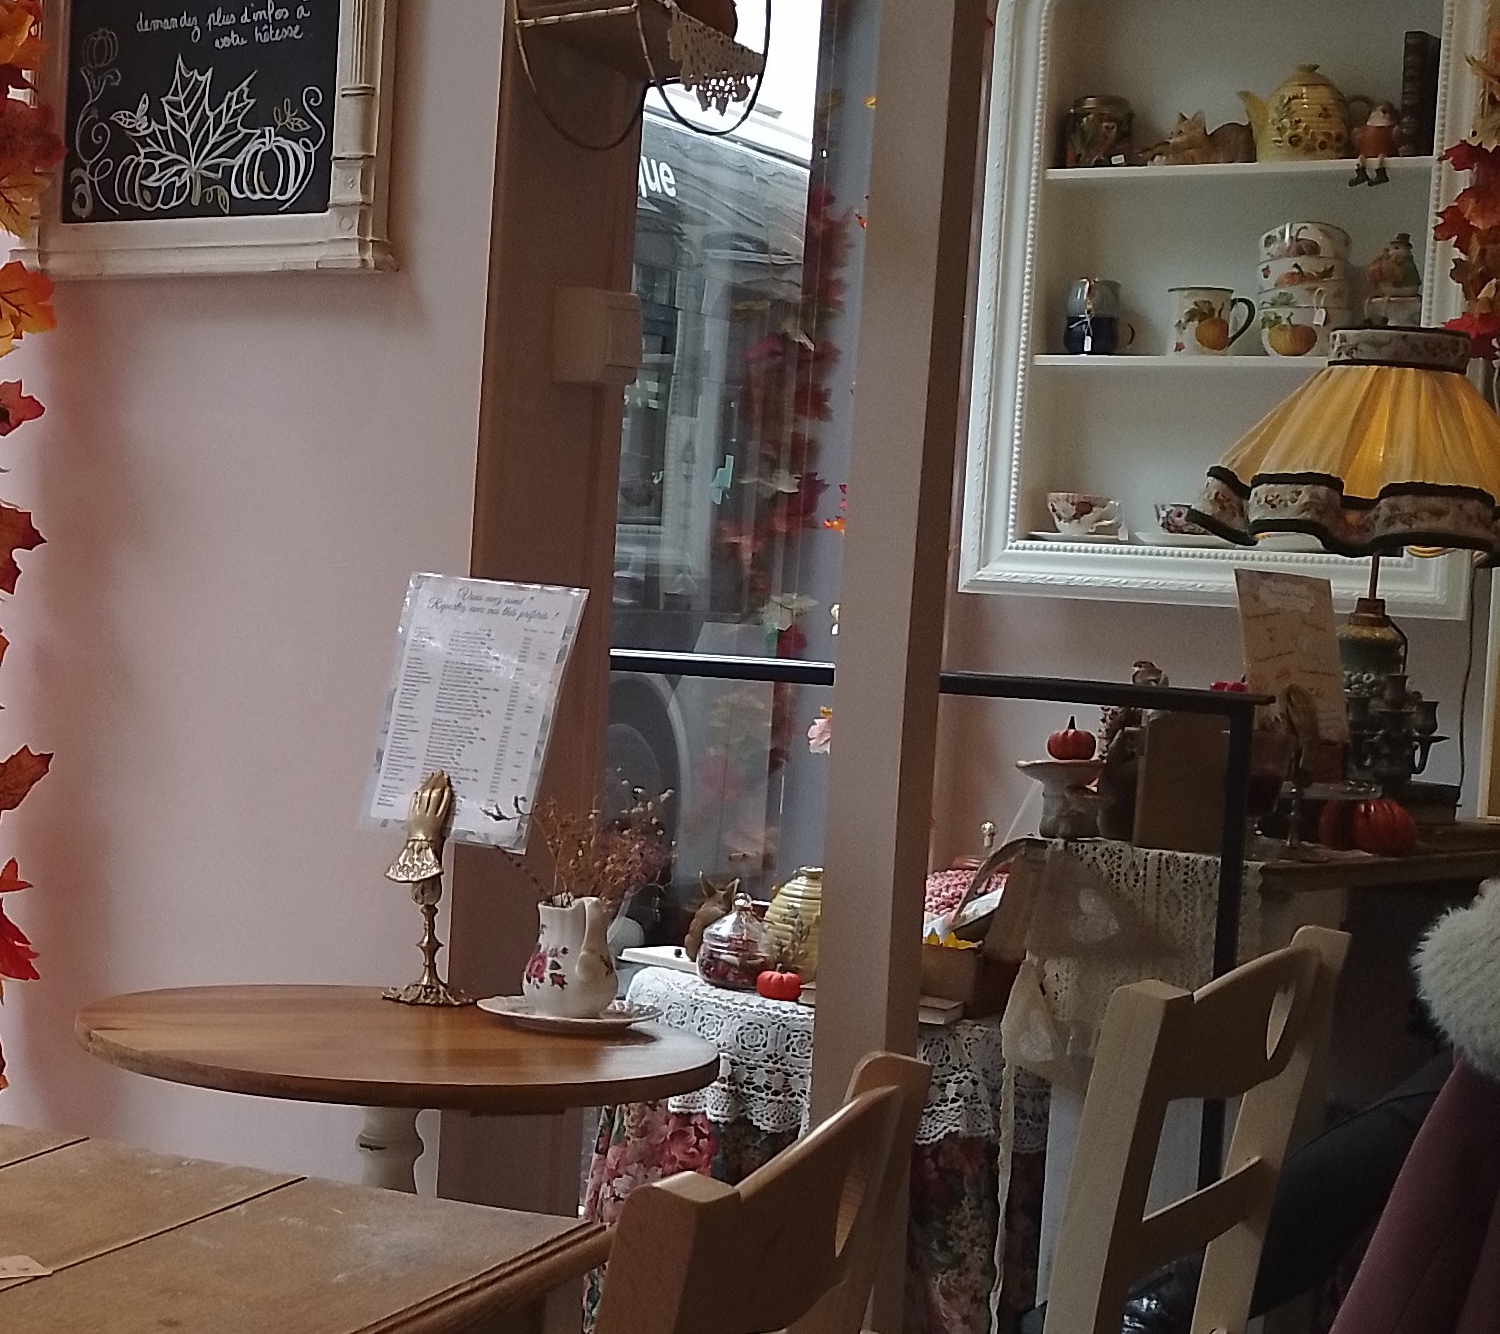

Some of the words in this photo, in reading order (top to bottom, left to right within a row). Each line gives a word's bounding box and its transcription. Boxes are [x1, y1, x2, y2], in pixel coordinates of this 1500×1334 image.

[136, 11, 200, 43] demandez
[206, 7, 236, 31] plus
[214, 29, 248, 49] votre
[255, 24, 304, 44] hôtesse
